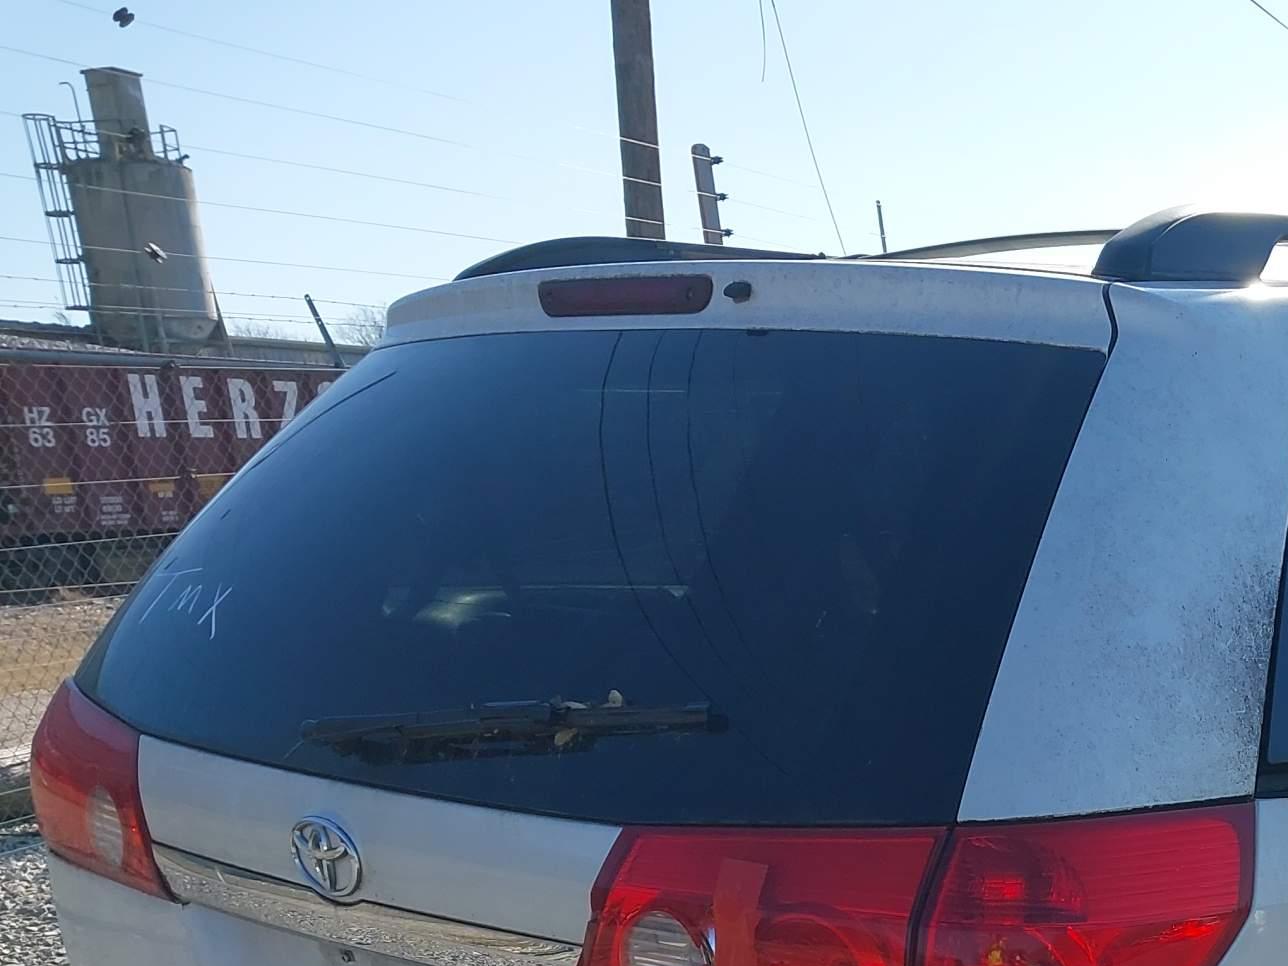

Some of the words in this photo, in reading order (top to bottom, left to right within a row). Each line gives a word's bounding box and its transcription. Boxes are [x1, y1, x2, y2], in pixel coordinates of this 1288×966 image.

[23, 406, 53, 426] HZ
[82, 407, 110, 427] GX
[127, 373, 335, 439] HERZ
[29, 428, 56, 448] 63
[86, 428, 111, 448] 85
